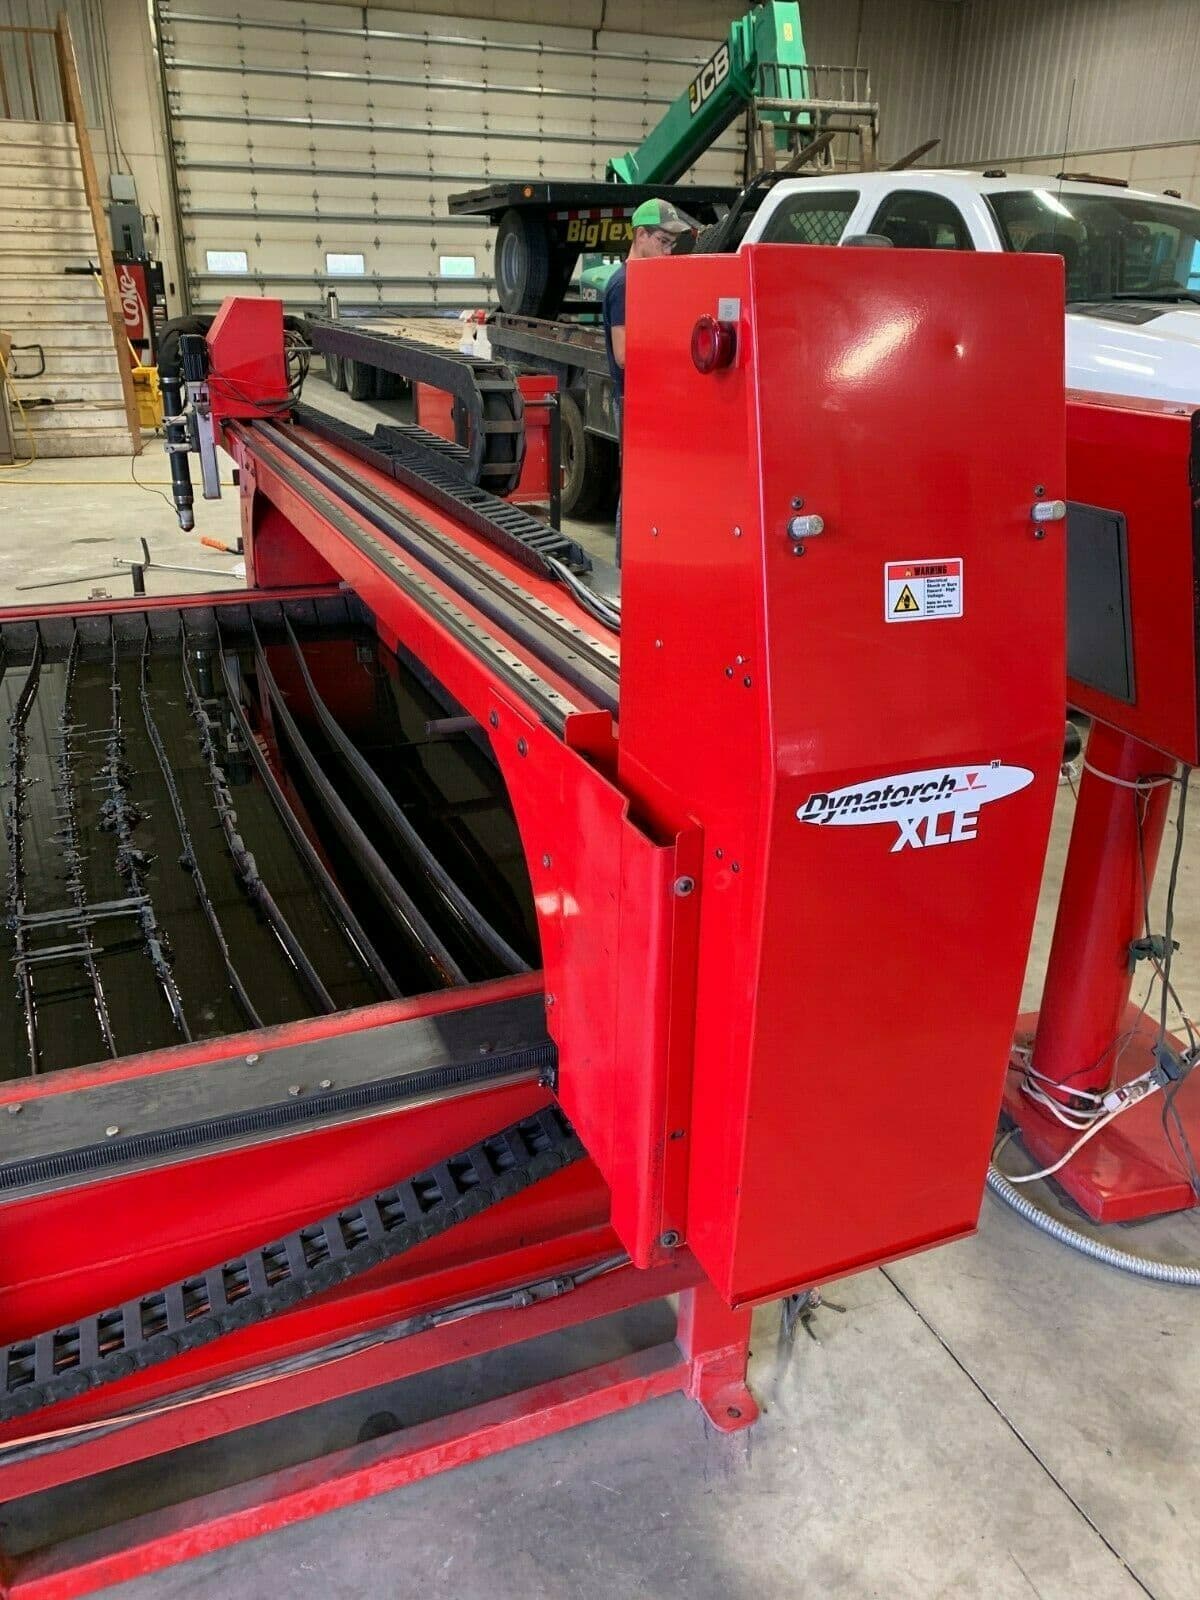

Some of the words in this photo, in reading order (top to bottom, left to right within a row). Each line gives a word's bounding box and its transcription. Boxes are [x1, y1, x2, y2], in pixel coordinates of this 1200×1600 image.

[690, 44, 730, 114] JCB
[914, 565, 948, 576] WARNING
[801, 774, 956, 824] Dynatorch
[891, 808, 979, 852] XLE
